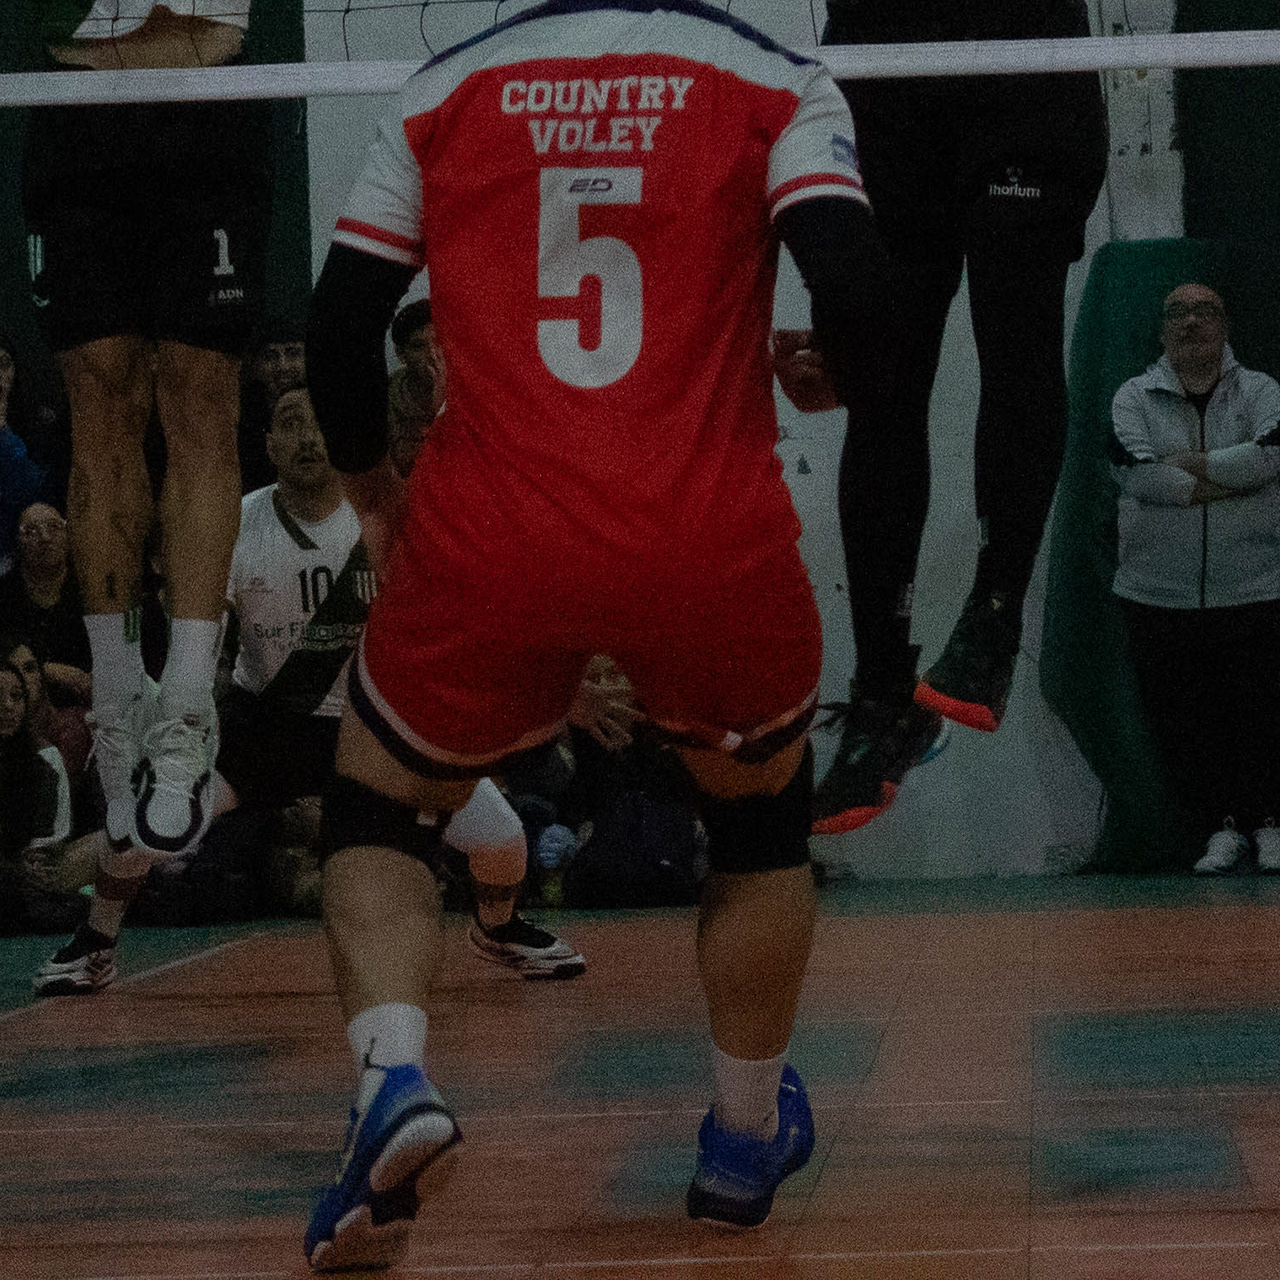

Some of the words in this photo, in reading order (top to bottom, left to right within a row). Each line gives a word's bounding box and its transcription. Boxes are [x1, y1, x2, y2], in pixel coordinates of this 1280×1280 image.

[500, 75, 694, 115] COUNTRY
[528, 116, 663, 155] VOLEY
[212, 228, 235, 276] 1
[537, 167, 644, 390] 5
[299, 566, 335, 613] 10
